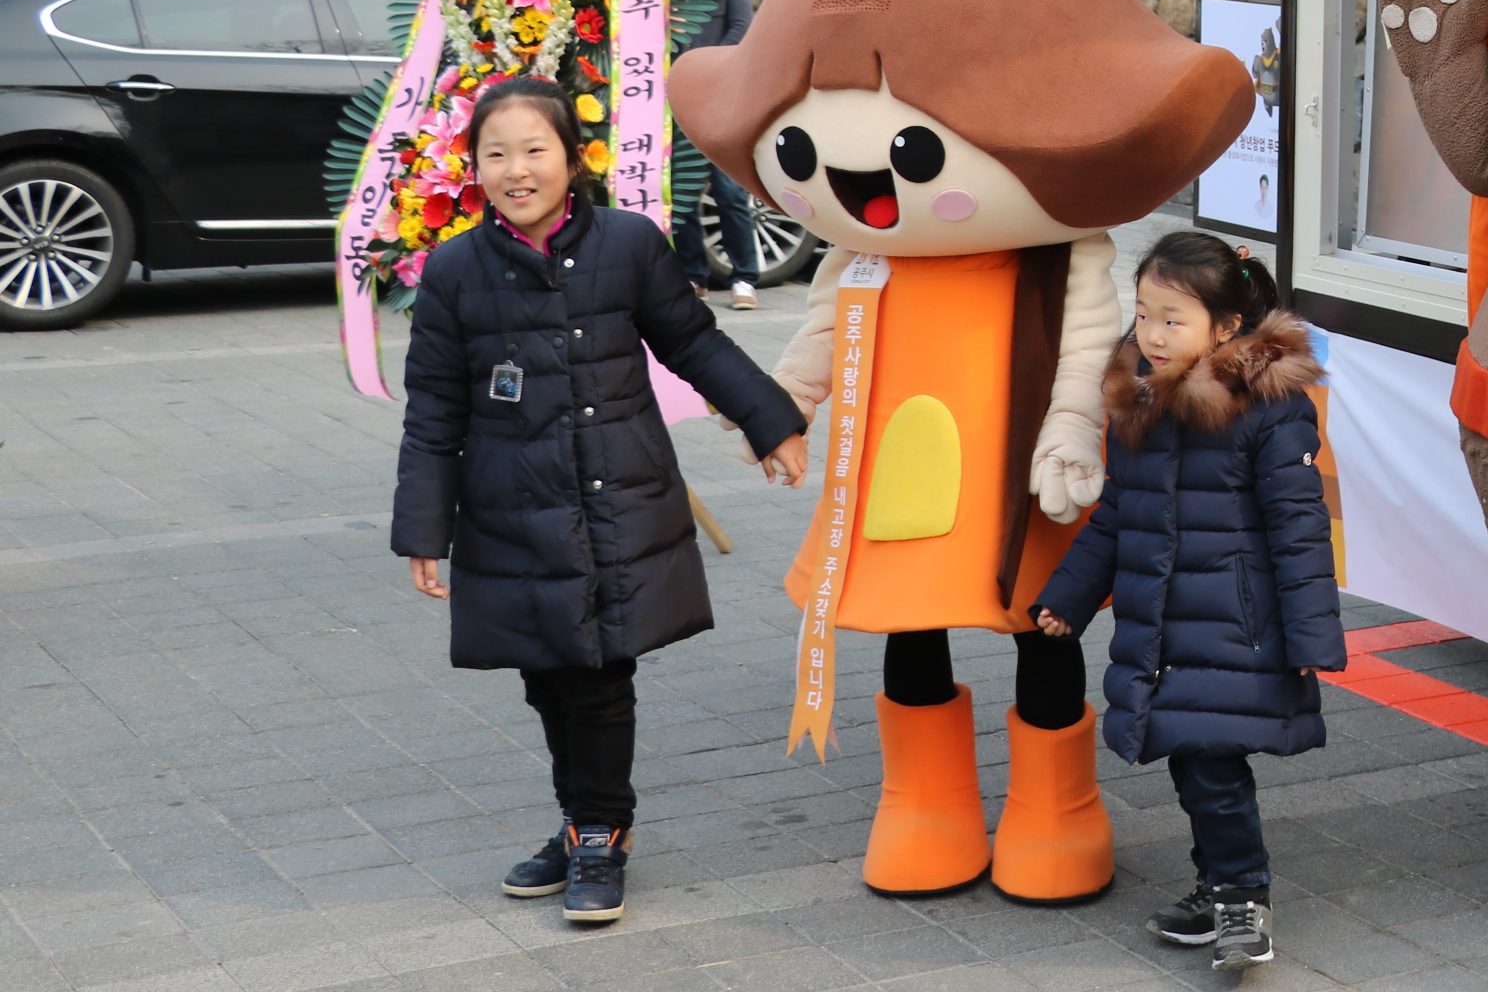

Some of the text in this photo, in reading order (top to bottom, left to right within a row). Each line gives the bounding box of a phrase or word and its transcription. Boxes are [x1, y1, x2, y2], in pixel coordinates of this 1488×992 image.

[623, 51, 655, 103] 있어
[852, 267, 875, 279] 공주시
[841, 304, 865, 408] 공주사랑의
[835, 415, 856, 478] 첫걸음
[829, 486, 847, 549] 내고장
[806, 647, 825, 711] 입니다
